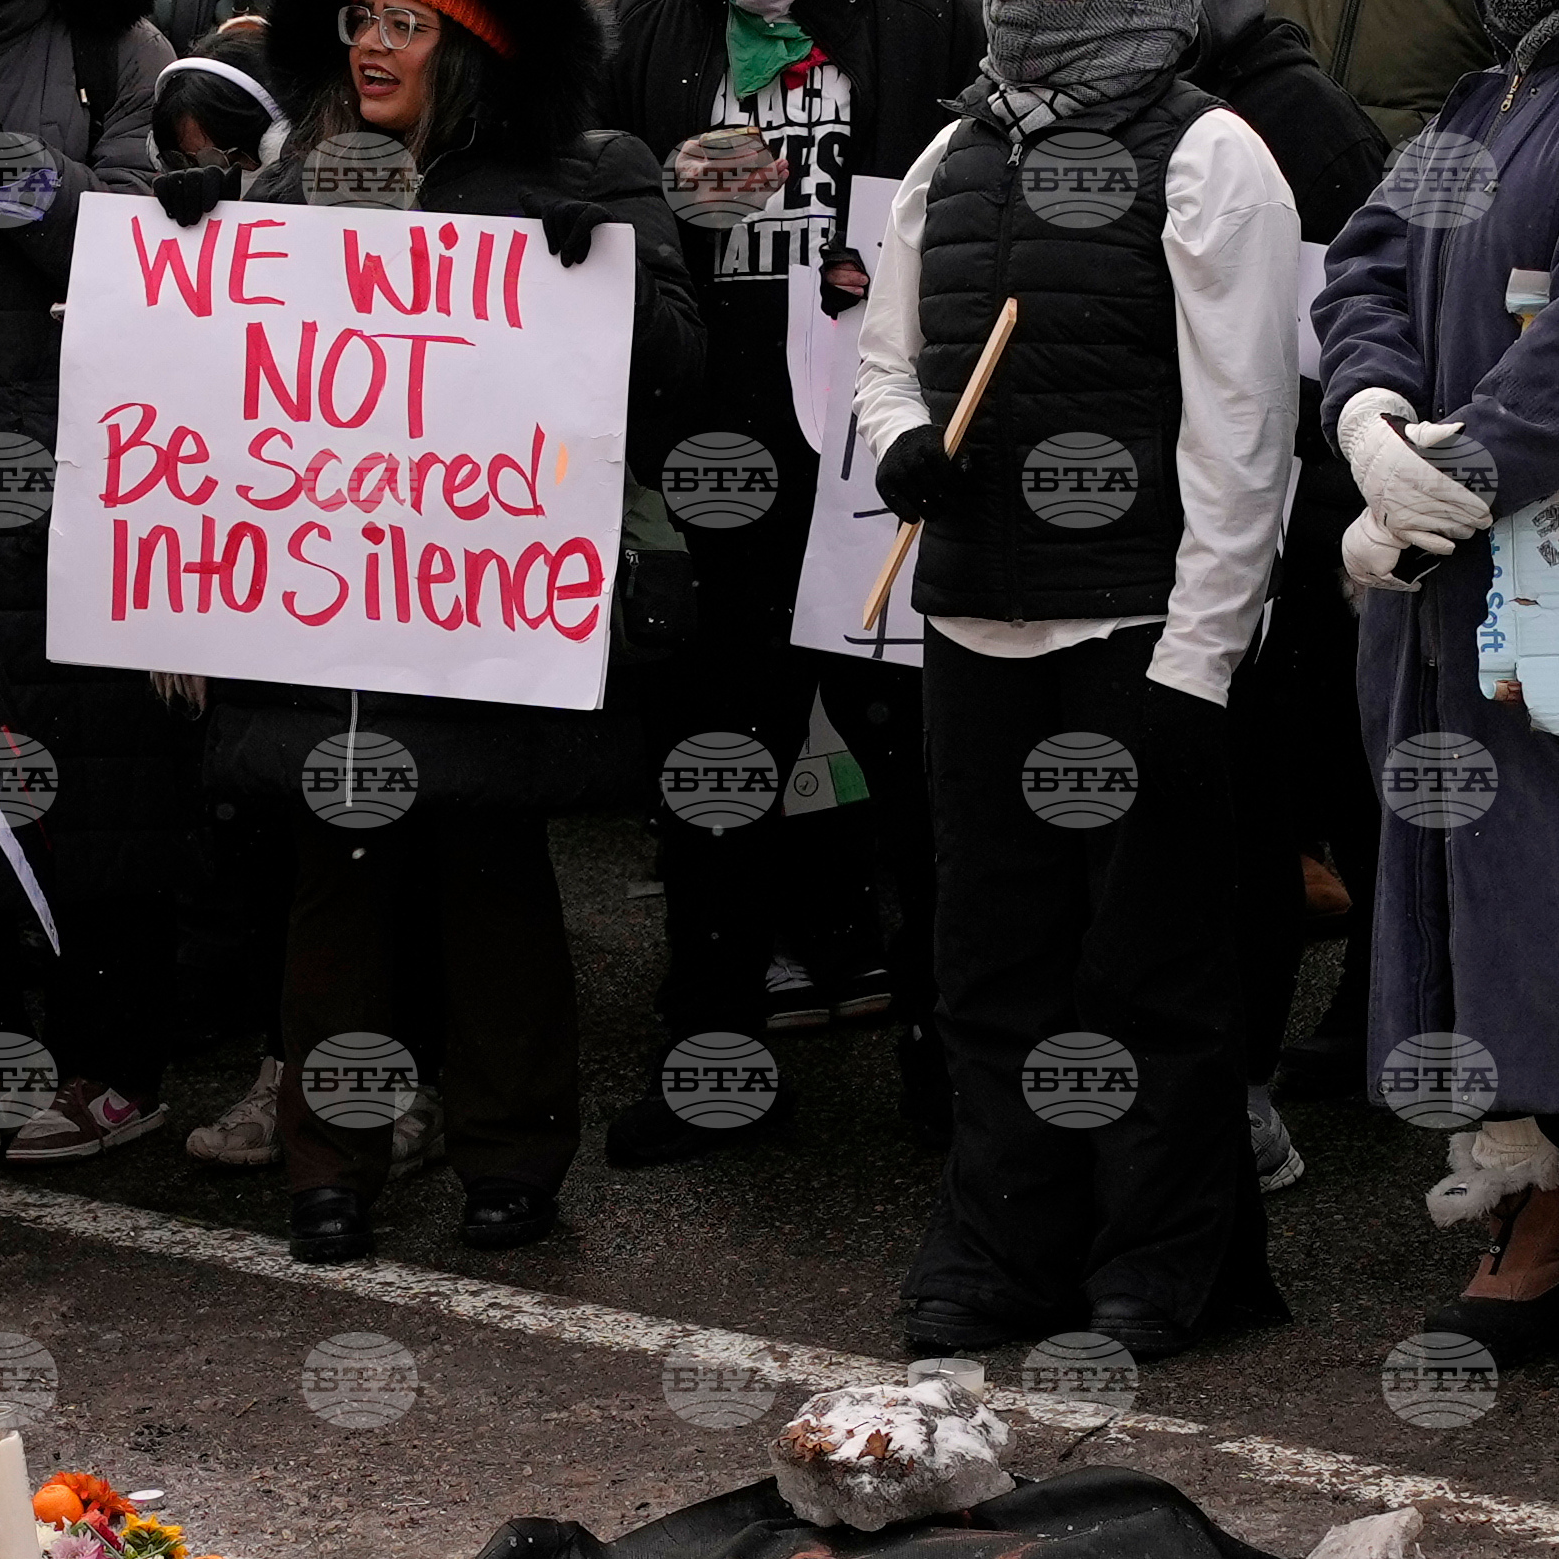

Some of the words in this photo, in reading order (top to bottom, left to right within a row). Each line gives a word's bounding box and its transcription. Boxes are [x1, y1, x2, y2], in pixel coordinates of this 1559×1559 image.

[130, 215, 289, 317] WE
[343, 221, 529, 330] Will
[714, 218, 834, 275] ATTE
[243, 319, 477, 440] NOT
[97, 401, 219, 509] Be
[235, 422, 546, 521] Scared
[281, 519, 606, 643] Silence
